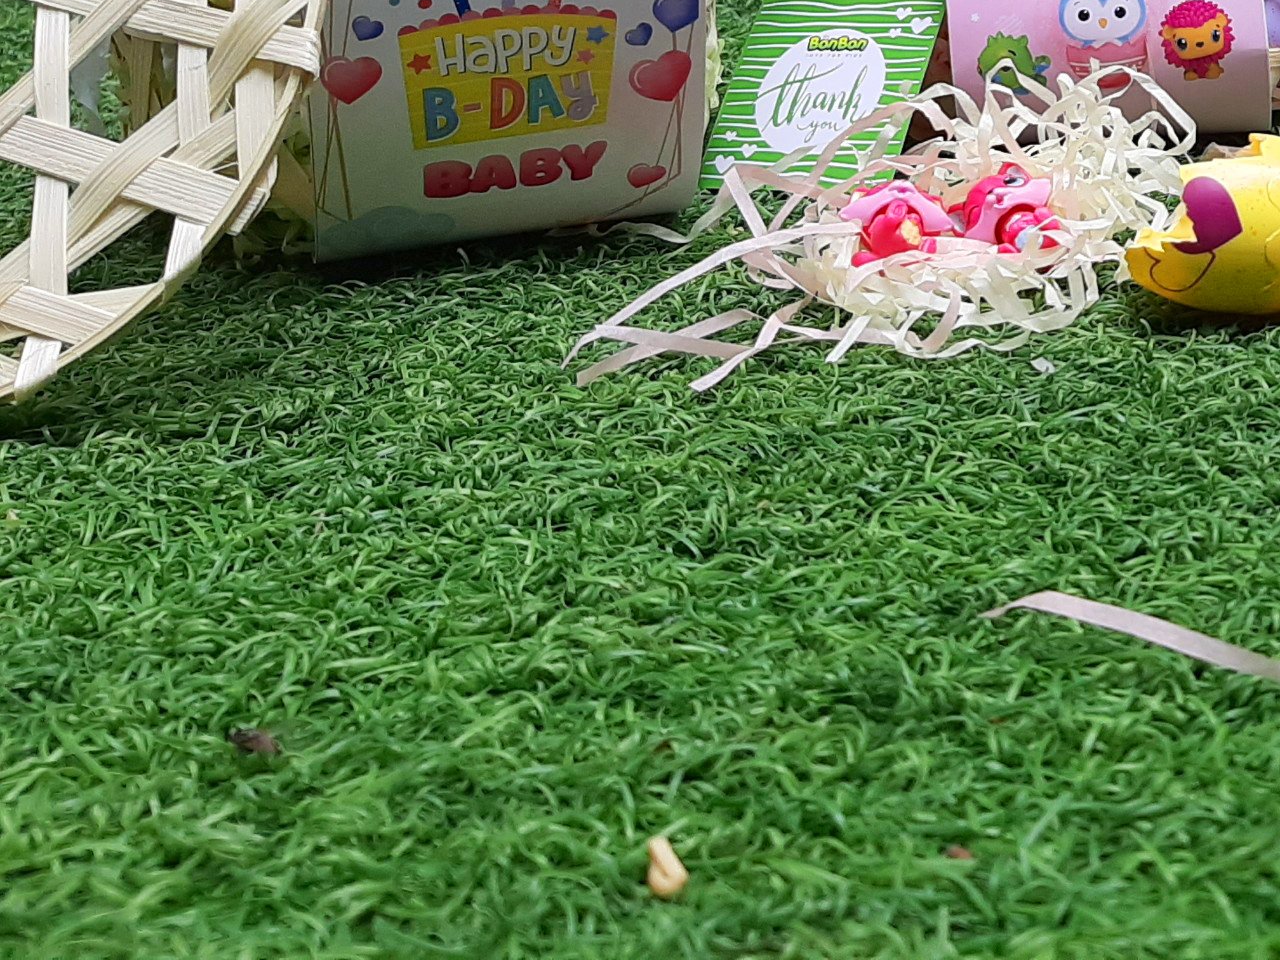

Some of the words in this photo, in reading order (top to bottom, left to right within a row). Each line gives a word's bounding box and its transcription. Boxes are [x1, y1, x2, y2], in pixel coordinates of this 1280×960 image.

[756, 62, 867, 133] thank
[797, 120, 844, 143] you
[422, 140, 608, 199] BABY
